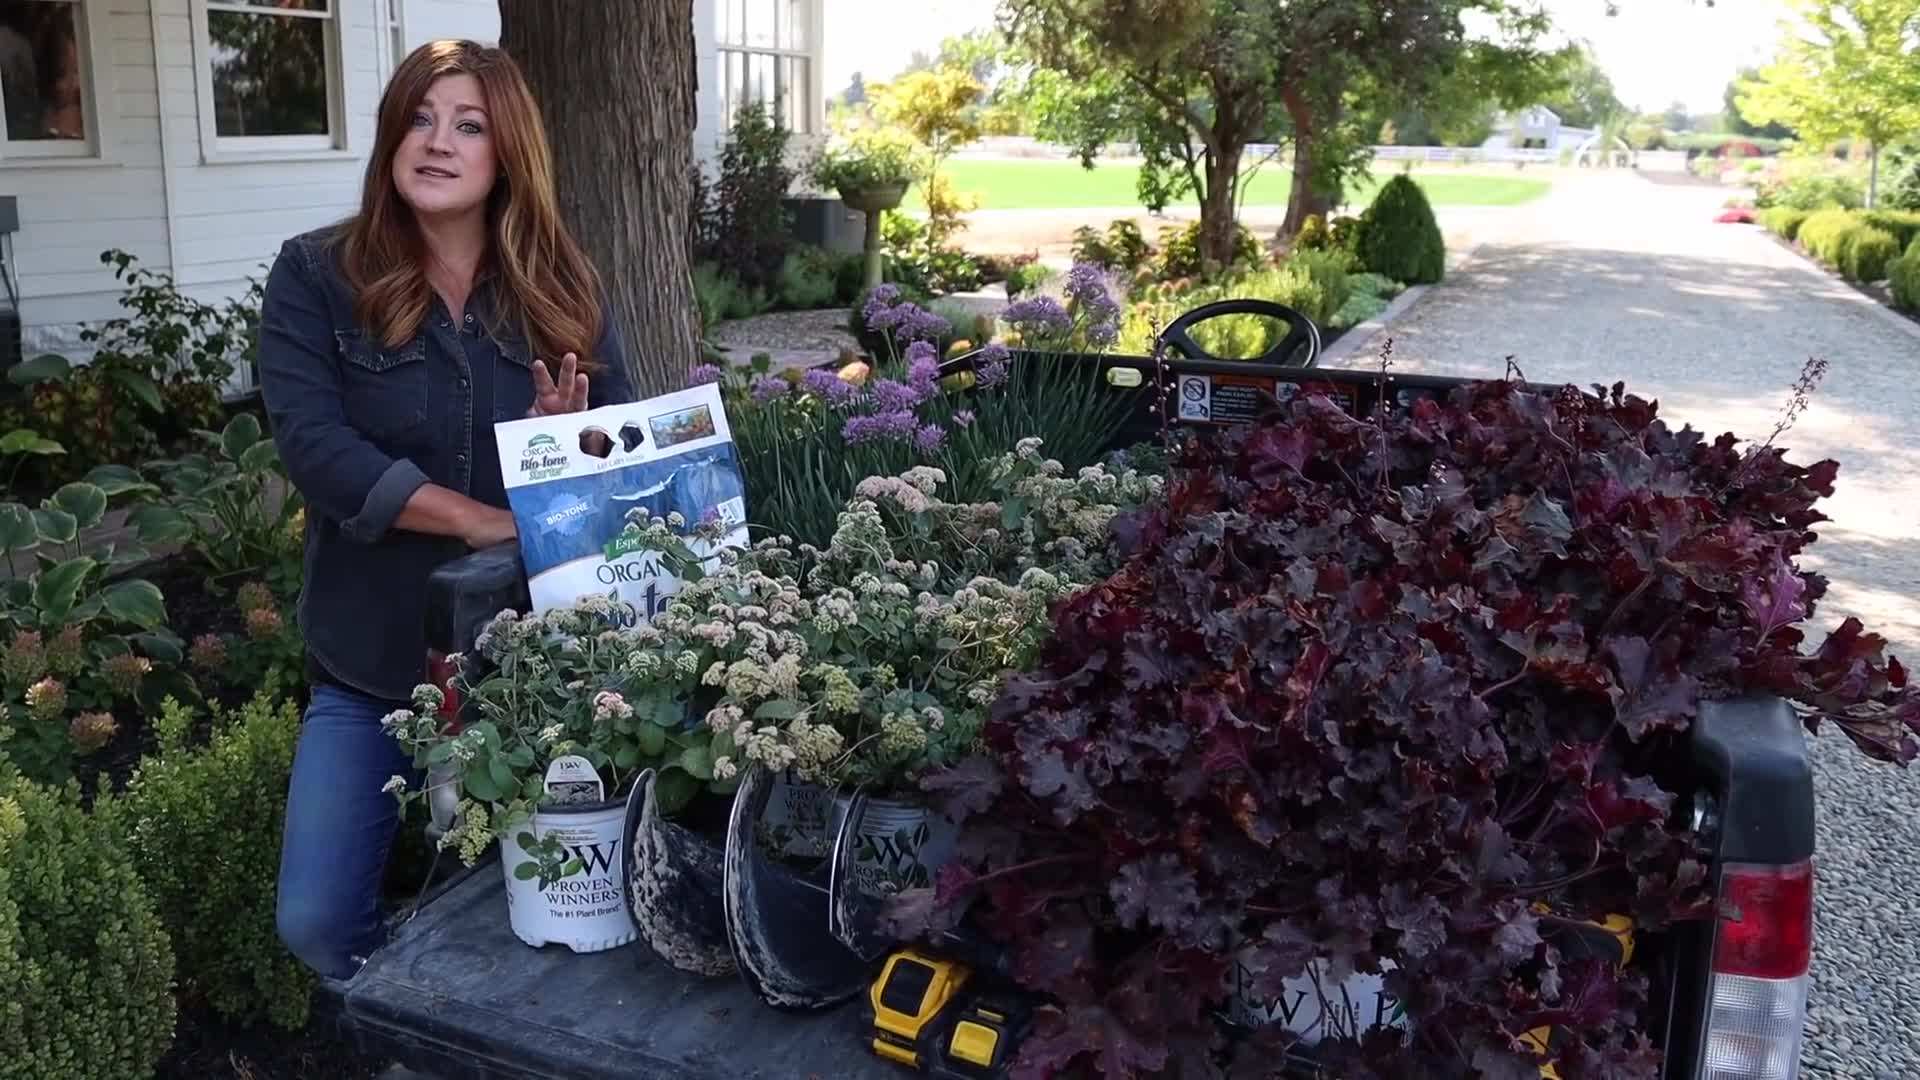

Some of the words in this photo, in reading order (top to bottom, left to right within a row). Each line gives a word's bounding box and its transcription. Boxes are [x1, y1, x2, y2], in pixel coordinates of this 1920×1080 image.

[546, 502, 589, 525] BIO-TONE
[596, 558, 667, 584] ORGAN
[551, 877, 614, 893] PROVEN
[545, 888, 621, 905] WINNERS
[550, 909, 563, 918] The
[576, 907, 596, 917] Plant
